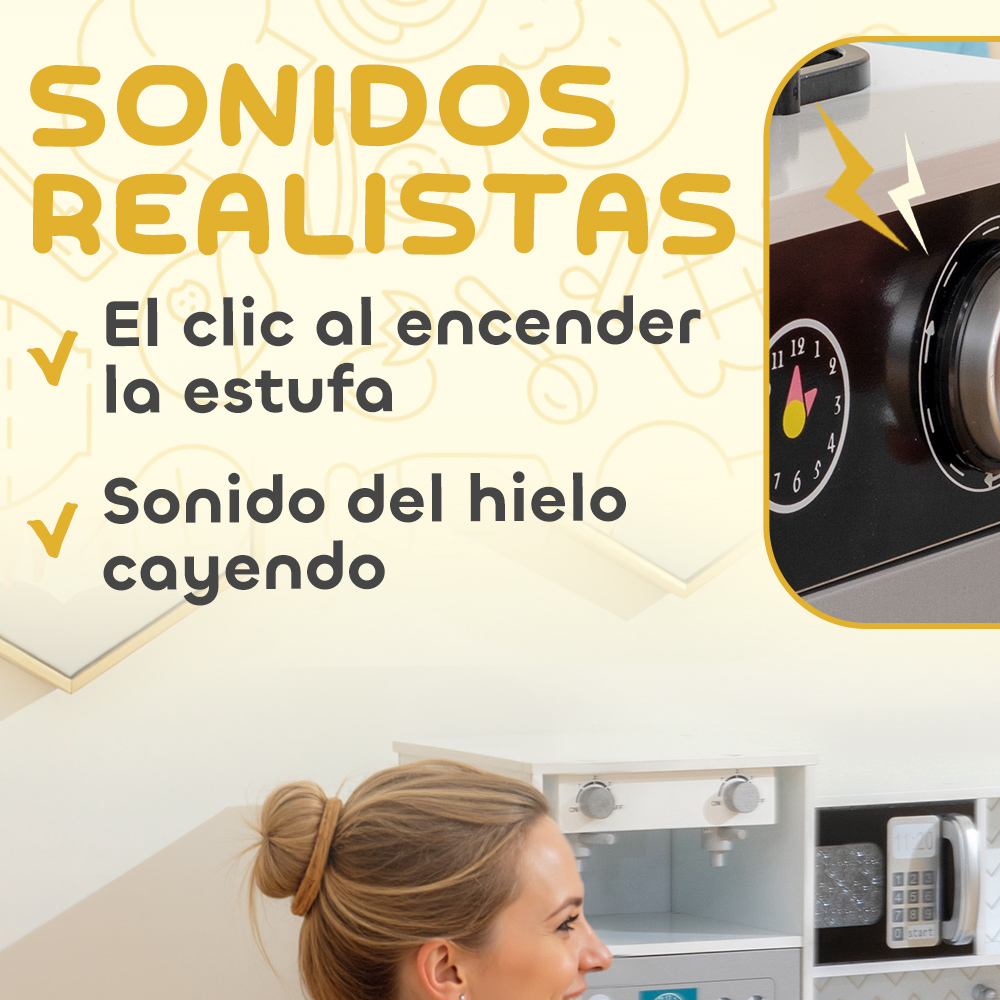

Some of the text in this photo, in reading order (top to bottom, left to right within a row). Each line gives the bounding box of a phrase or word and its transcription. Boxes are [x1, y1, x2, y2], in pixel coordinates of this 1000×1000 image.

[790, 337, 805, 358] 12
[814, 340, 820, 358] 1
[771, 350, 784, 370] 11
[829, 357, 837, 375] 2
[834, 395, 841, 415] 3
[827, 432, 836, 453] 4
[813, 460, 821, 480] 5
[773, 472, 781, 489] 7
[793, 470, 801, 493] 6
[907, 927, 934, 938] start
